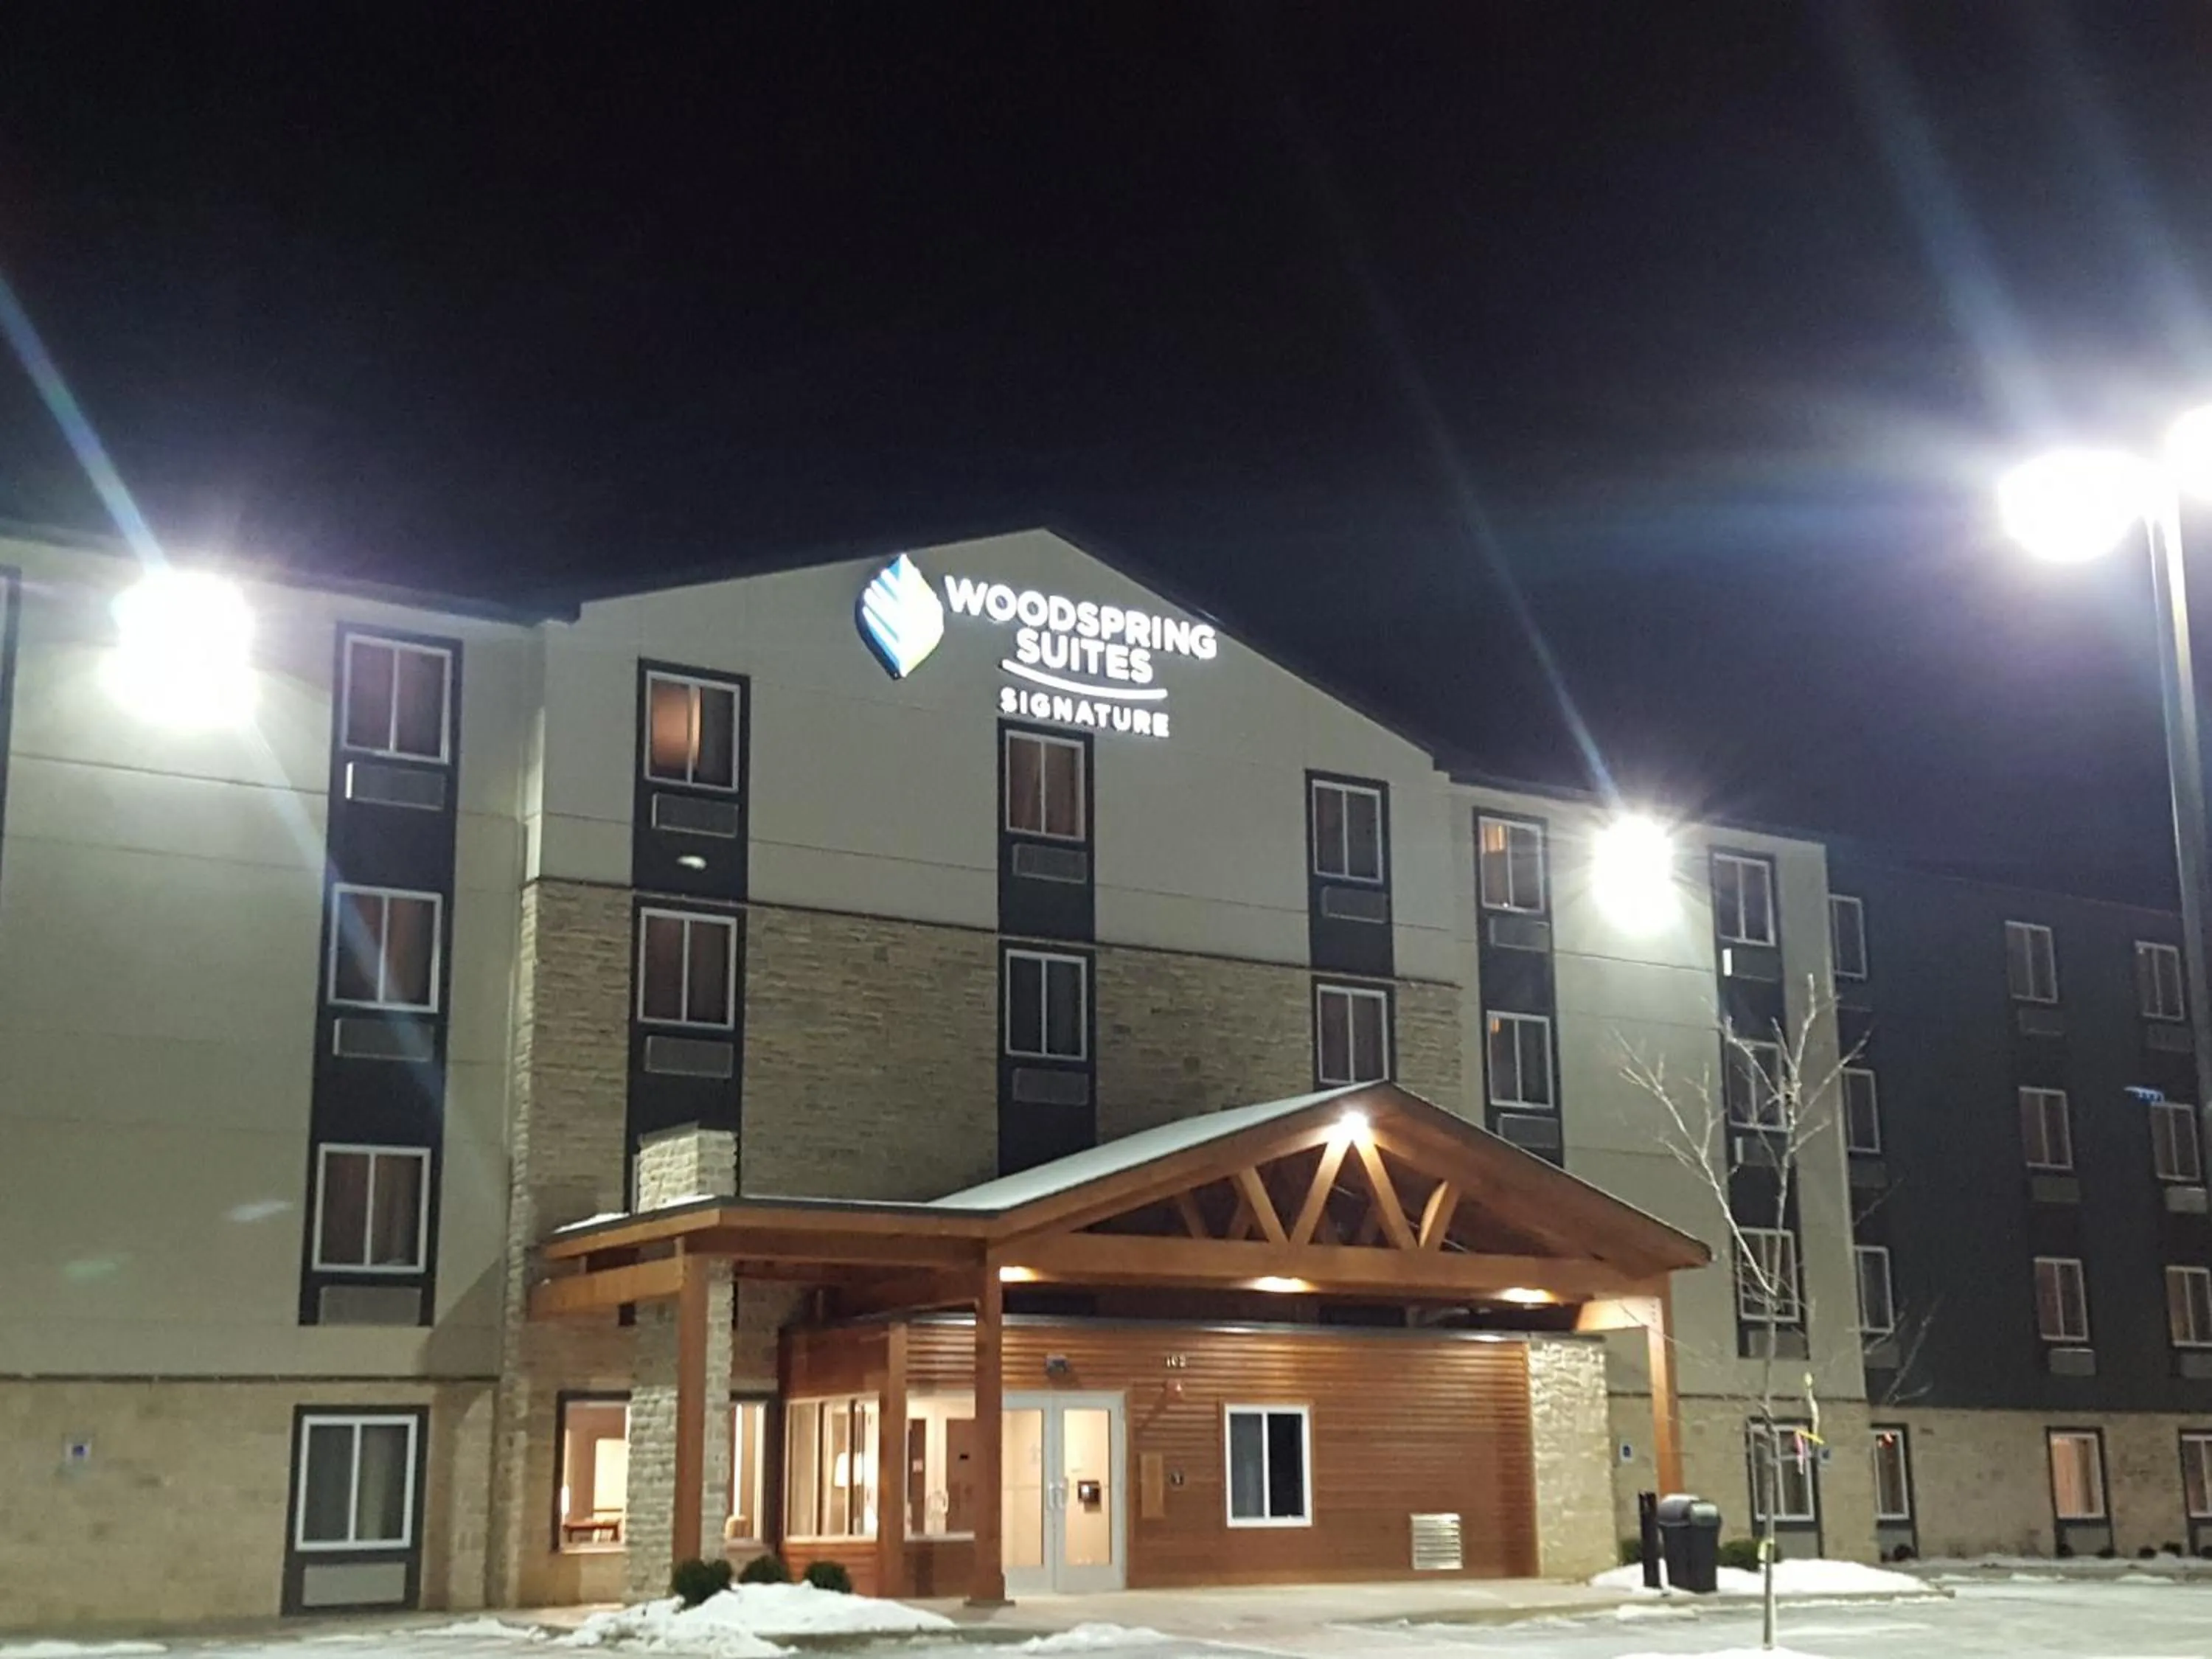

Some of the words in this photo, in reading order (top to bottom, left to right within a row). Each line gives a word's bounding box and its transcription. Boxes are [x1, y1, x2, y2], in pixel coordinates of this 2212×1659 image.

[945, 575, 1217, 660] WOODSPRING
[1017, 627, 1153, 684] SUITES
[1001, 686, 1169, 737] SIGNATURE
